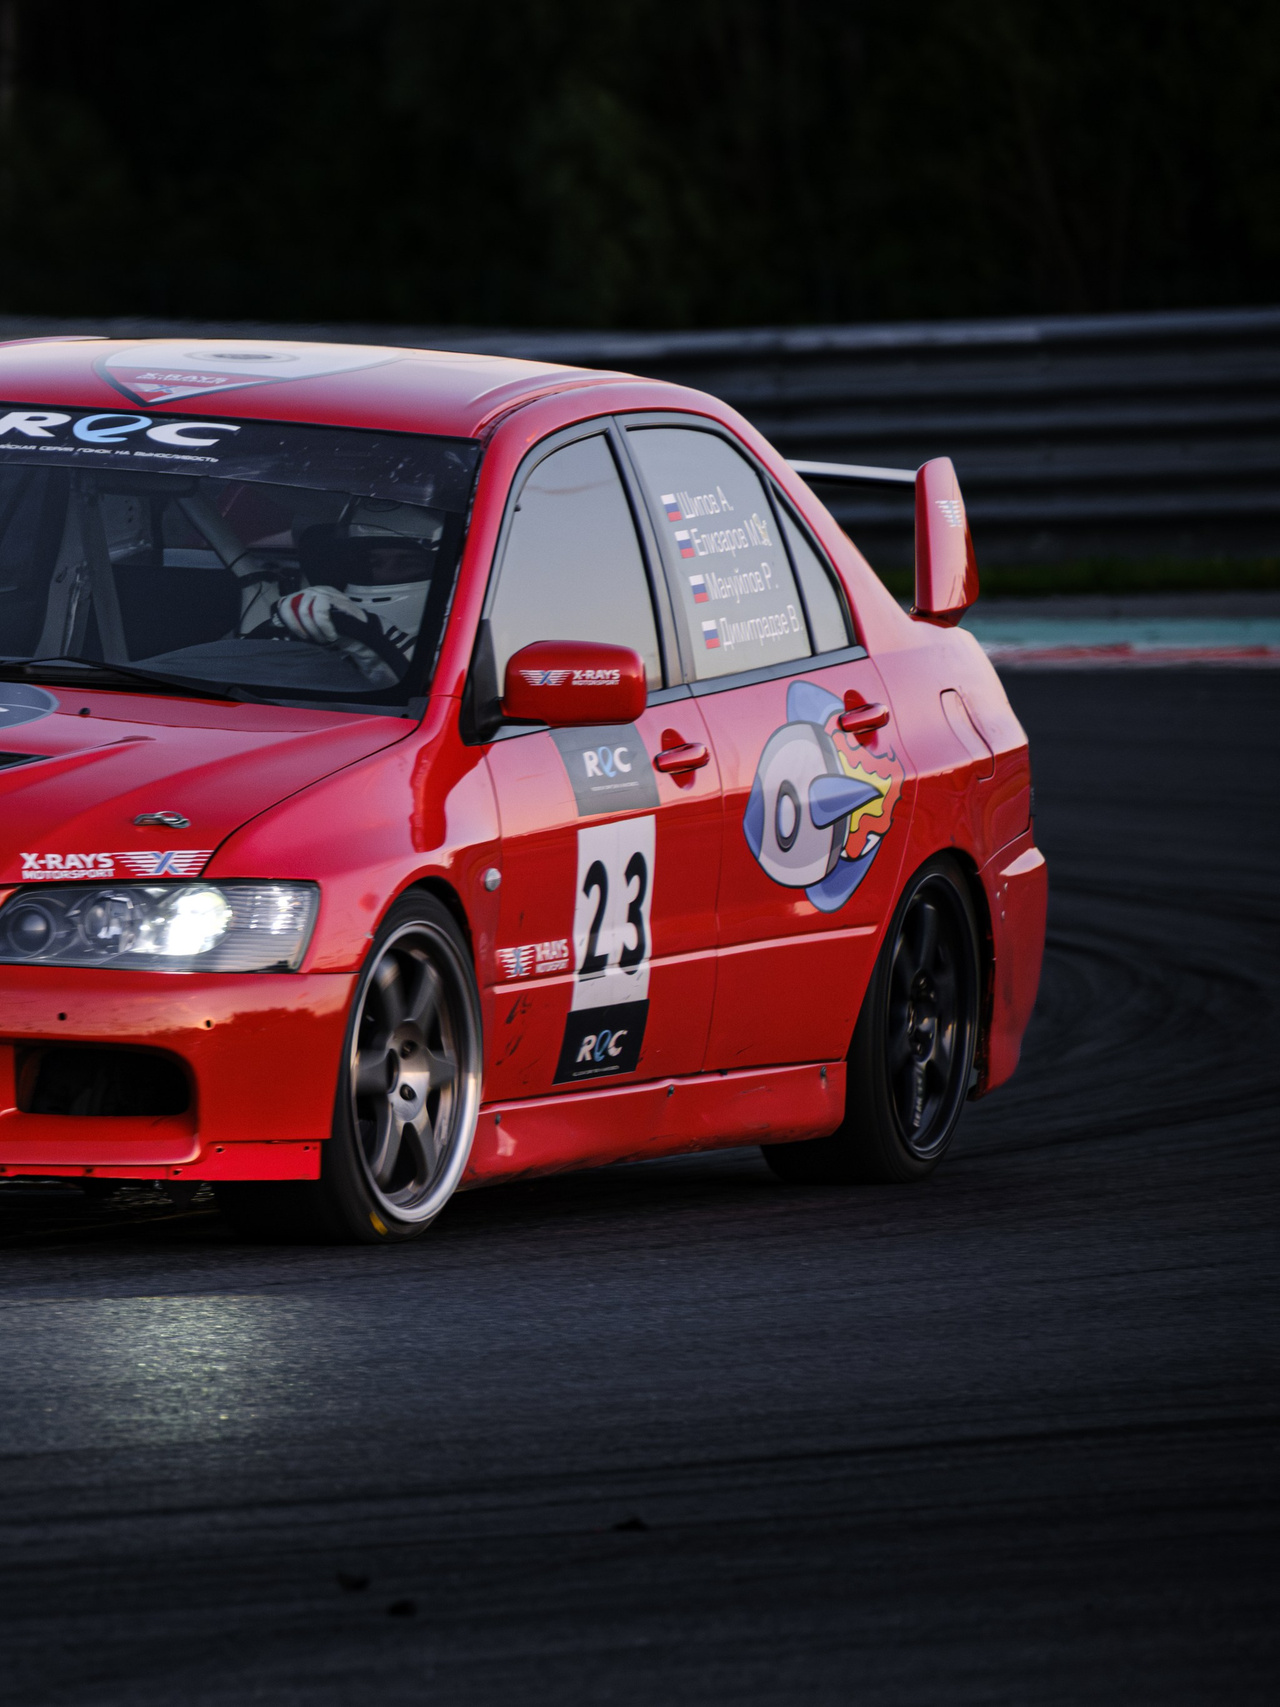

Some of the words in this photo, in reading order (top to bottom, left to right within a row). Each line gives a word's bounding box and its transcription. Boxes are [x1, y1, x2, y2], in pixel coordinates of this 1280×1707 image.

[676, 491, 720, 519] Шипов
[716, 485, 734, 512] А.
[691, 525, 749, 558] Елизаров
[705, 568, 765, 604] Мануйлов
[718, 611, 789, 652] Димитрадзе
[786, 604, 804, 633] В.
[572, 669, 620, 680] X-RAYS
[20, 853, 115, 869] X-RAYS
[22, 868, 115, 879] MOTORSPORT
[578, 851, 648, 982] 23
